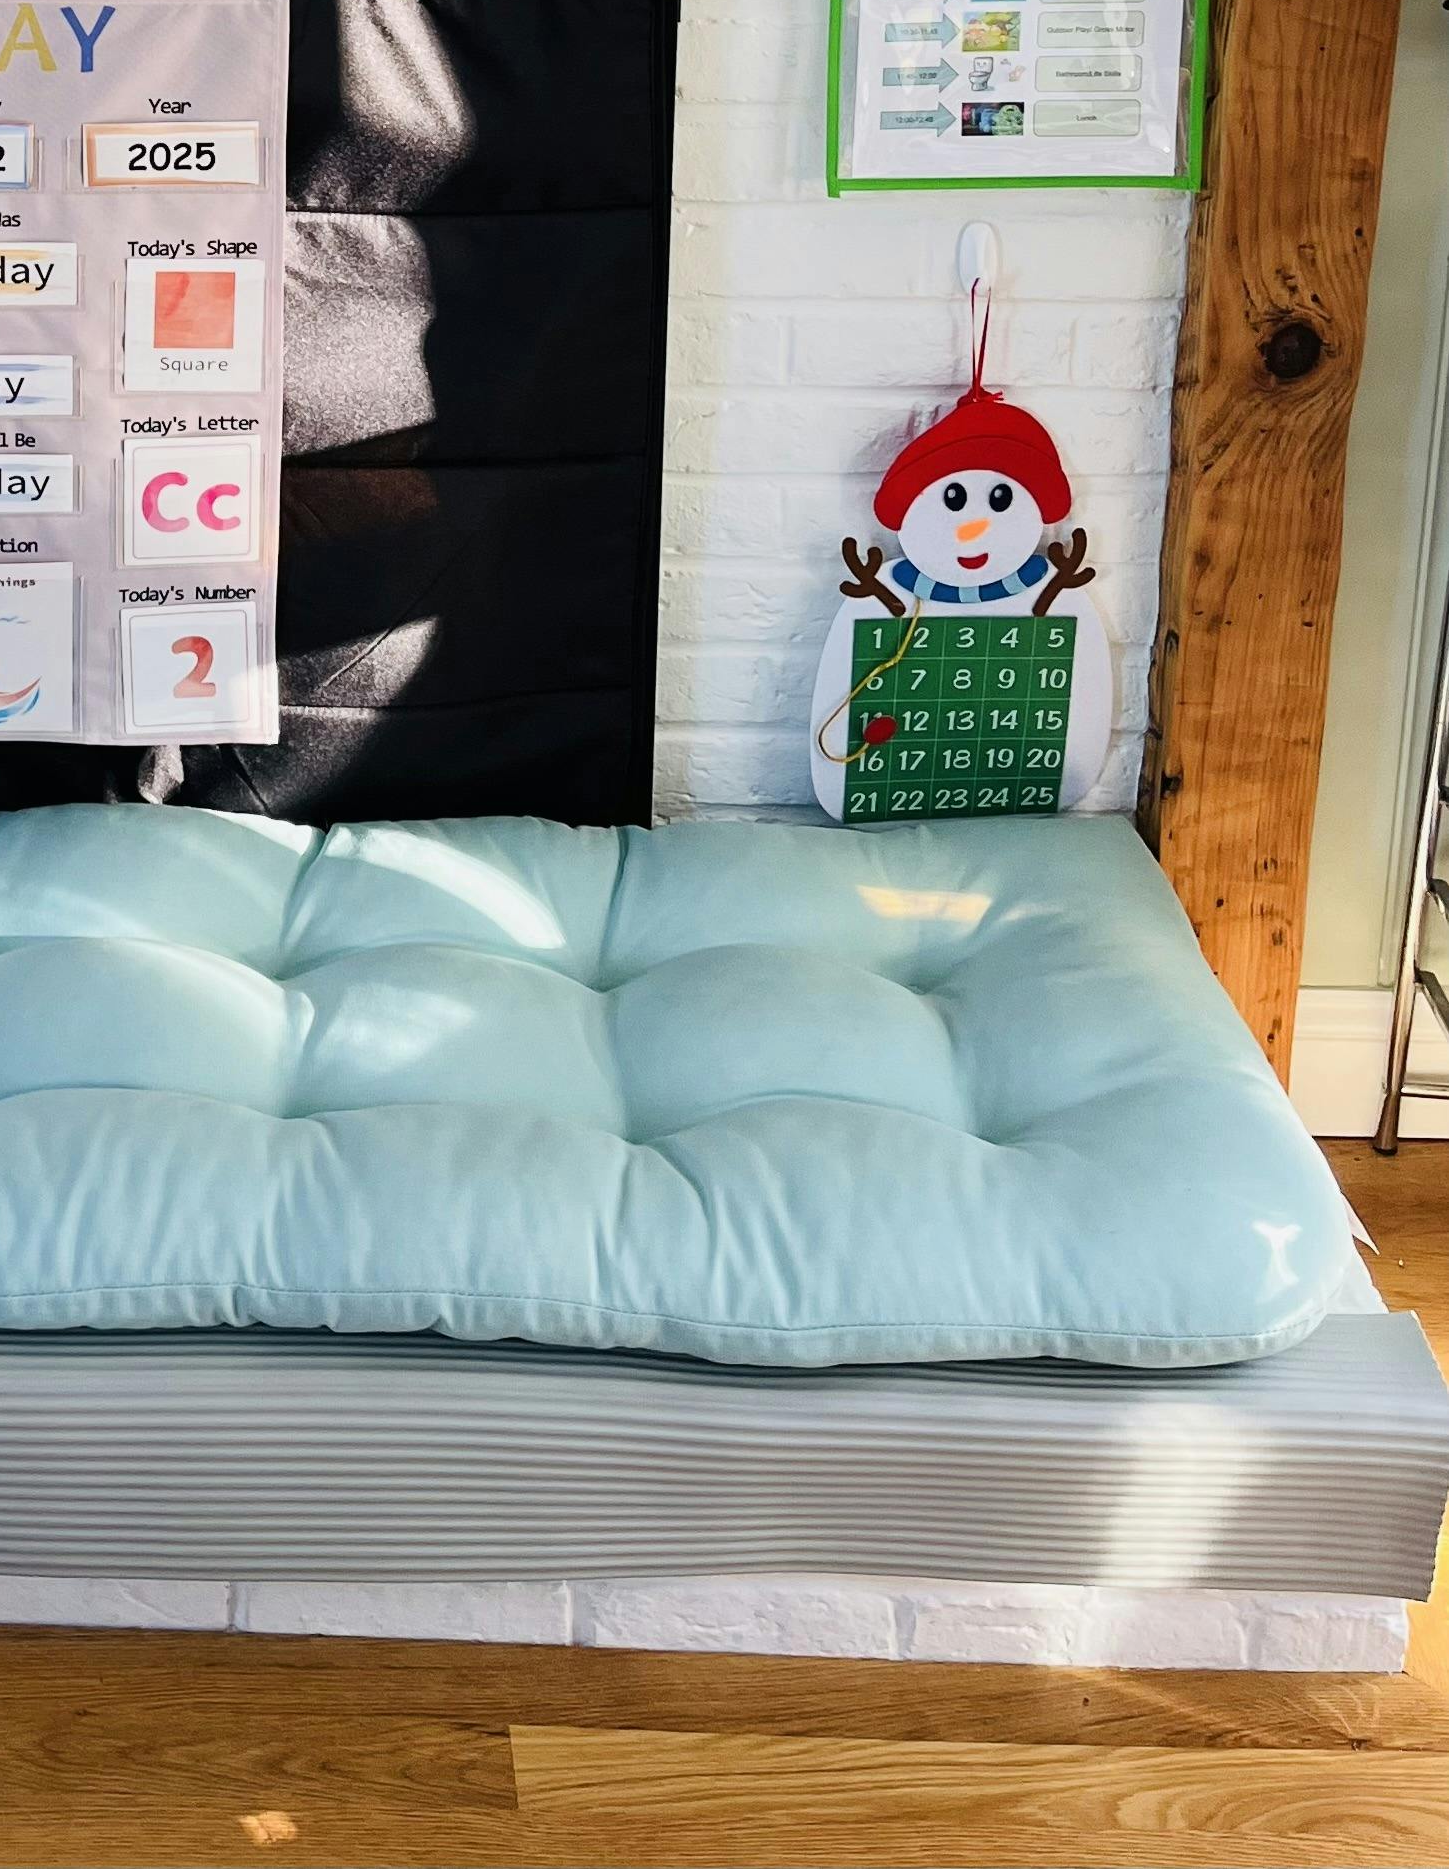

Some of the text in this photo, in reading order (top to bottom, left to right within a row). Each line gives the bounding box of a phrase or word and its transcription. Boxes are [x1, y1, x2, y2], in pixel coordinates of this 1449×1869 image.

[148, 97, 191, 116] Year
[127, 142, 217, 172] 2025
[127, 239, 258, 259] Today's Shape
[160, 356, 229, 375] Square
[120, 415, 259, 435] Today's Letter
[15, 433, 36, 449] Be
[141, 471, 242, 533] Cc
[119, 584, 257, 605] Today's Number
[873, 628, 1066, 649] 1 2 3 4 5
[171, 635, 217, 699] 2
[910, 670, 927, 691] 7
[952, 669, 972, 690] 8
[997, 668, 1016, 689] 9
[1038, 668, 1068, 689] 10
[901, 709, 1064, 732] 12 13 14 15
[858, 748, 1062, 772] 16 17 18 19 20
[850, 786, 1054, 813] 21 22 23 24 25
